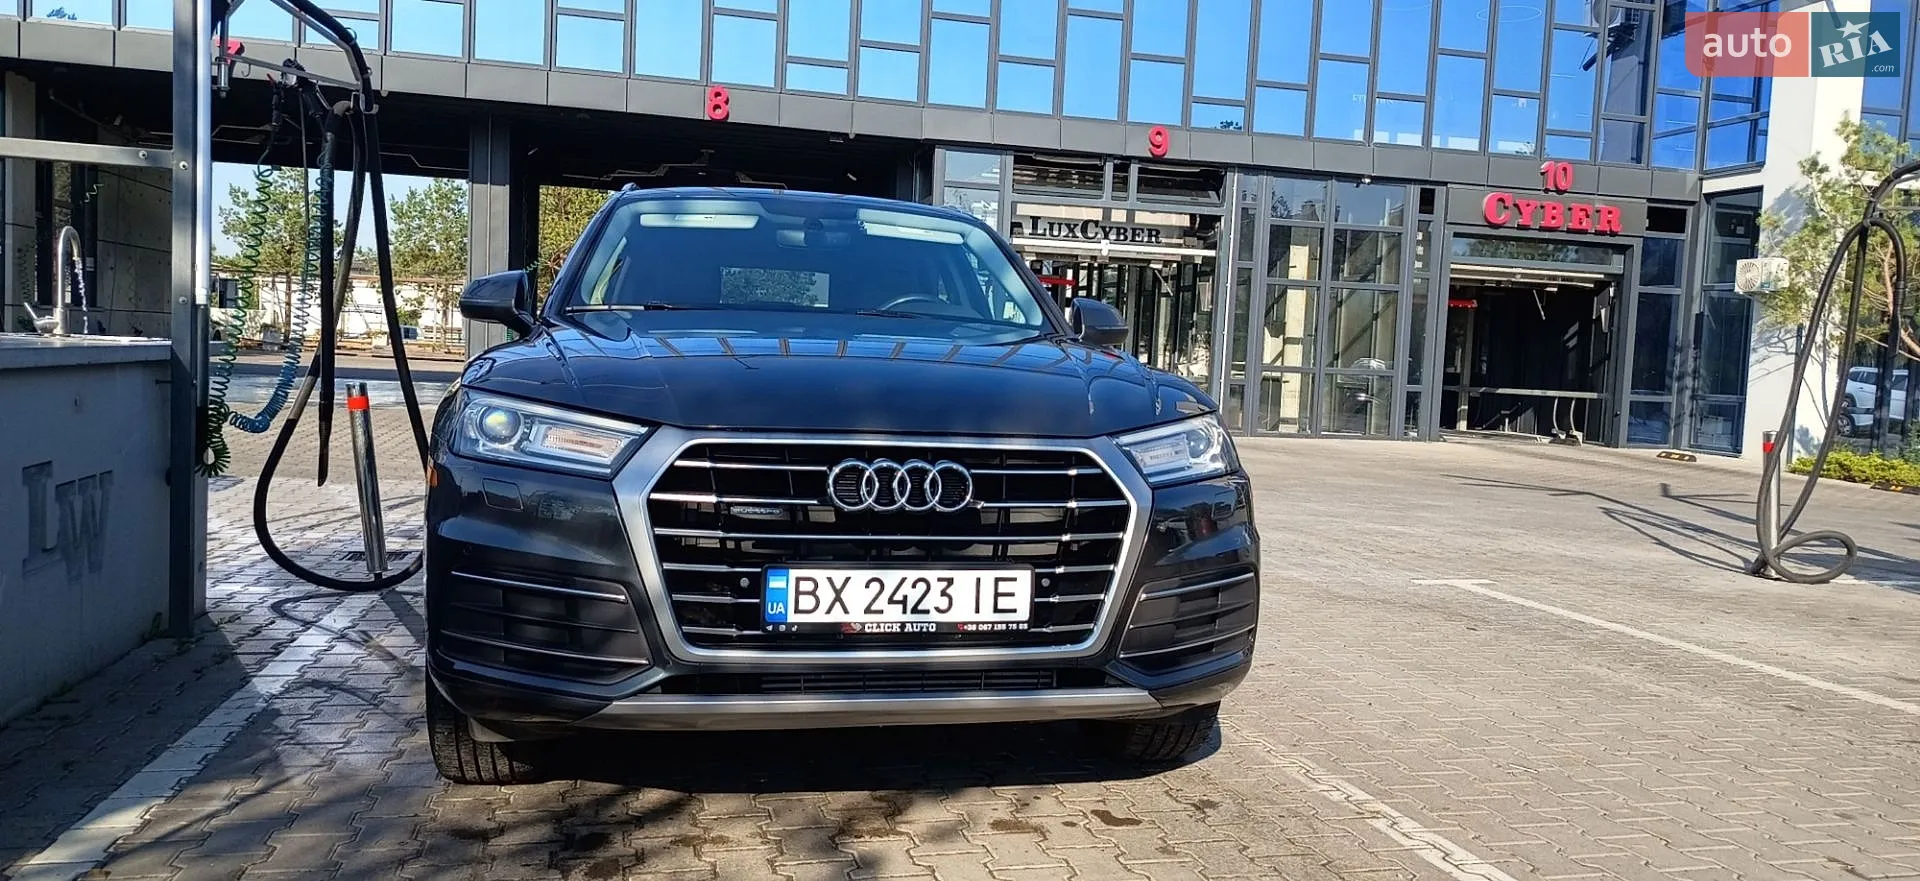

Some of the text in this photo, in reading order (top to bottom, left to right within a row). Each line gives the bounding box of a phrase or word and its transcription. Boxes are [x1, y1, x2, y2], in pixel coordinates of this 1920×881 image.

[707, 84, 730, 120] 8
[1148, 125, 1170, 157] 9
[1540, 160, 1574, 194] 10
[768, 601, 785, 615] UA
[793, 576, 1018, 615] BX 2423 IE
[864, 623, 937, 632] CLICK AUTO
